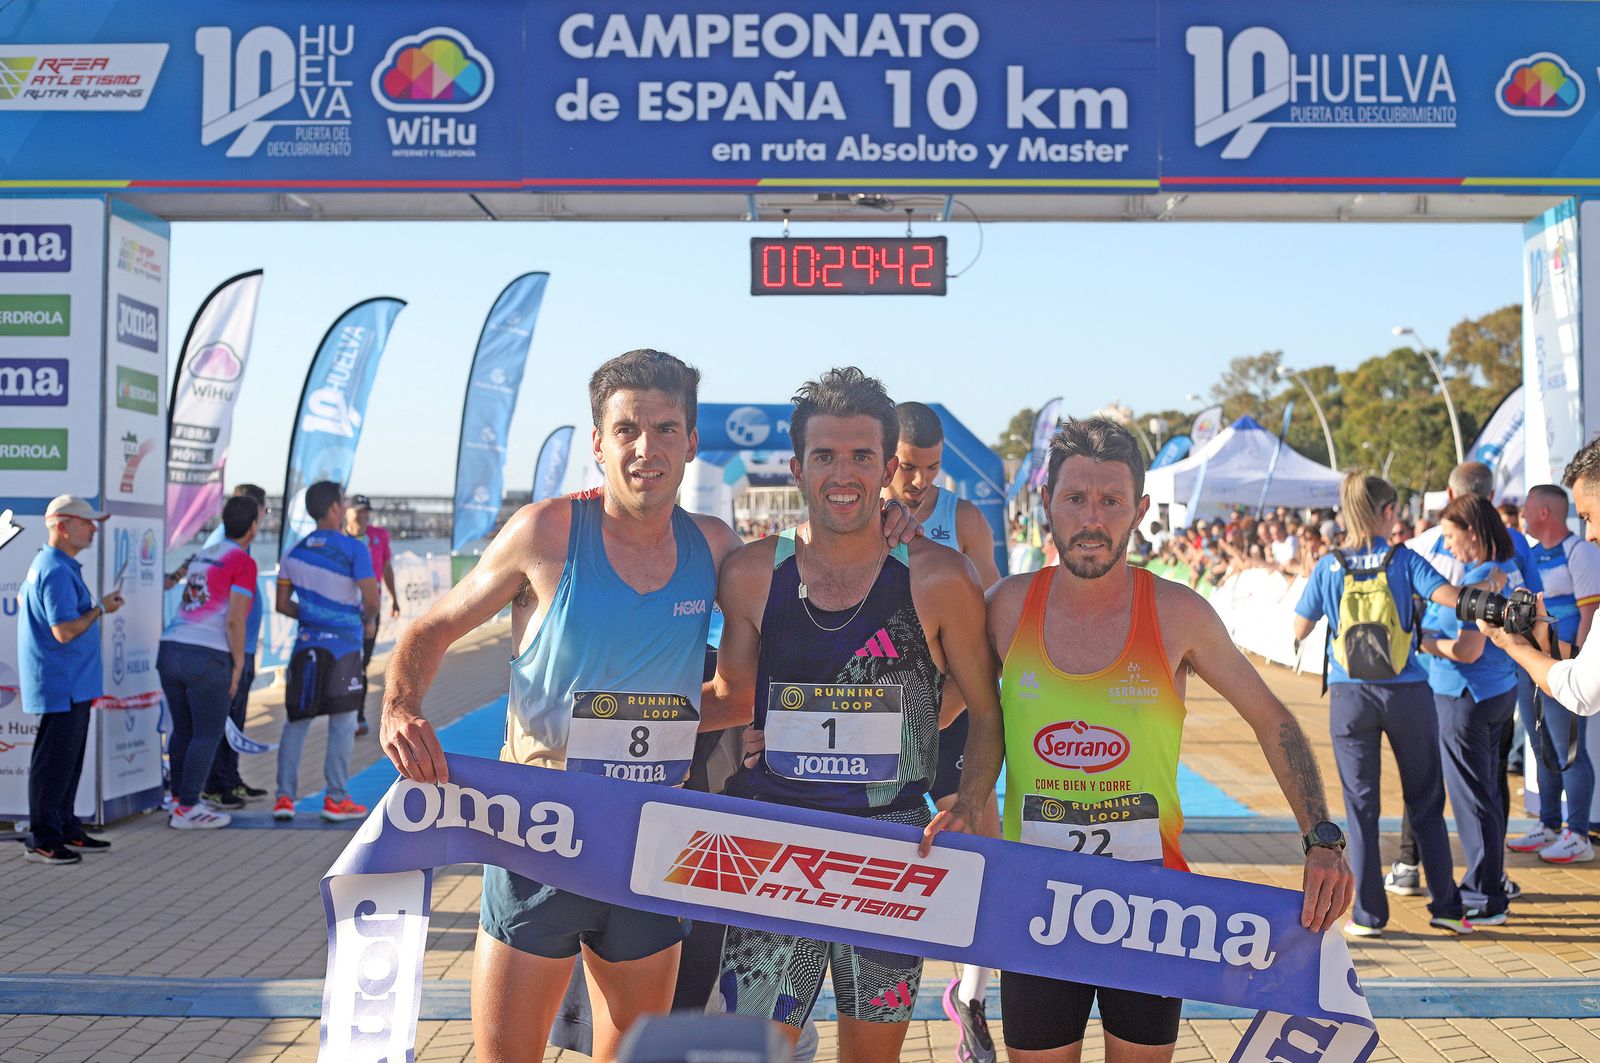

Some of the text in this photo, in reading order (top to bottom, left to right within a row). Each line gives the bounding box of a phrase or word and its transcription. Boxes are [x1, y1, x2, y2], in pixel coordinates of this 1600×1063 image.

[558, 12, 980, 60] CAMPEONATO
[37, 57, 110, 74] RFEA
[30, 75, 142, 86] ATLETISMO
[1290, 53, 1457, 104] HUELVA
[23, 89, 145, 100] RUTA RUNNING
[554, 65, 1129, 131] de ESPAÑA 10 km
[1290, 105, 1457, 122] PUERTA DEL DESCUBRIMIENTO
[295, 126, 351, 141] PUERTA DEL
[386, 114, 478, 146] WiHu
[266, 141, 352, 157] DESCUBRIMIENTO
[711, 135, 1129, 170] en ruta Absoluto y Master
[762, 245, 935, 287] 00:29:42
[117, 302, 158, 342] Joma
[326, 325, 366, 389] HUELVA
[192, 383, 234, 402] WiHu
[672, 599, 706, 617] HOKA
[627, 695, 688, 706] RUNNING
[814, 687, 885, 698] RUNNING
[1108, 686, 1159, 697] SERRANO
[643, 709, 679, 719] LOOP
[831, 700, 873, 711] LOOP
[628, 725, 651, 758] 8
[821, 717, 836, 750] 1
[1041, 733, 1123, 757] Serrano
[793, 755, 869, 776] Joma
[1035, 778, 1132, 792] COME BIEN Y CORRE
[1071, 796, 1141, 812] RUNNING
[1089, 810, 1131, 823] LOOP
[1068, 828, 1114, 858] 22
[769, 843, 950, 898] RFEA
[755, 882, 927, 923] ATLETISMO
[1028, 879, 1277, 971] Joma
